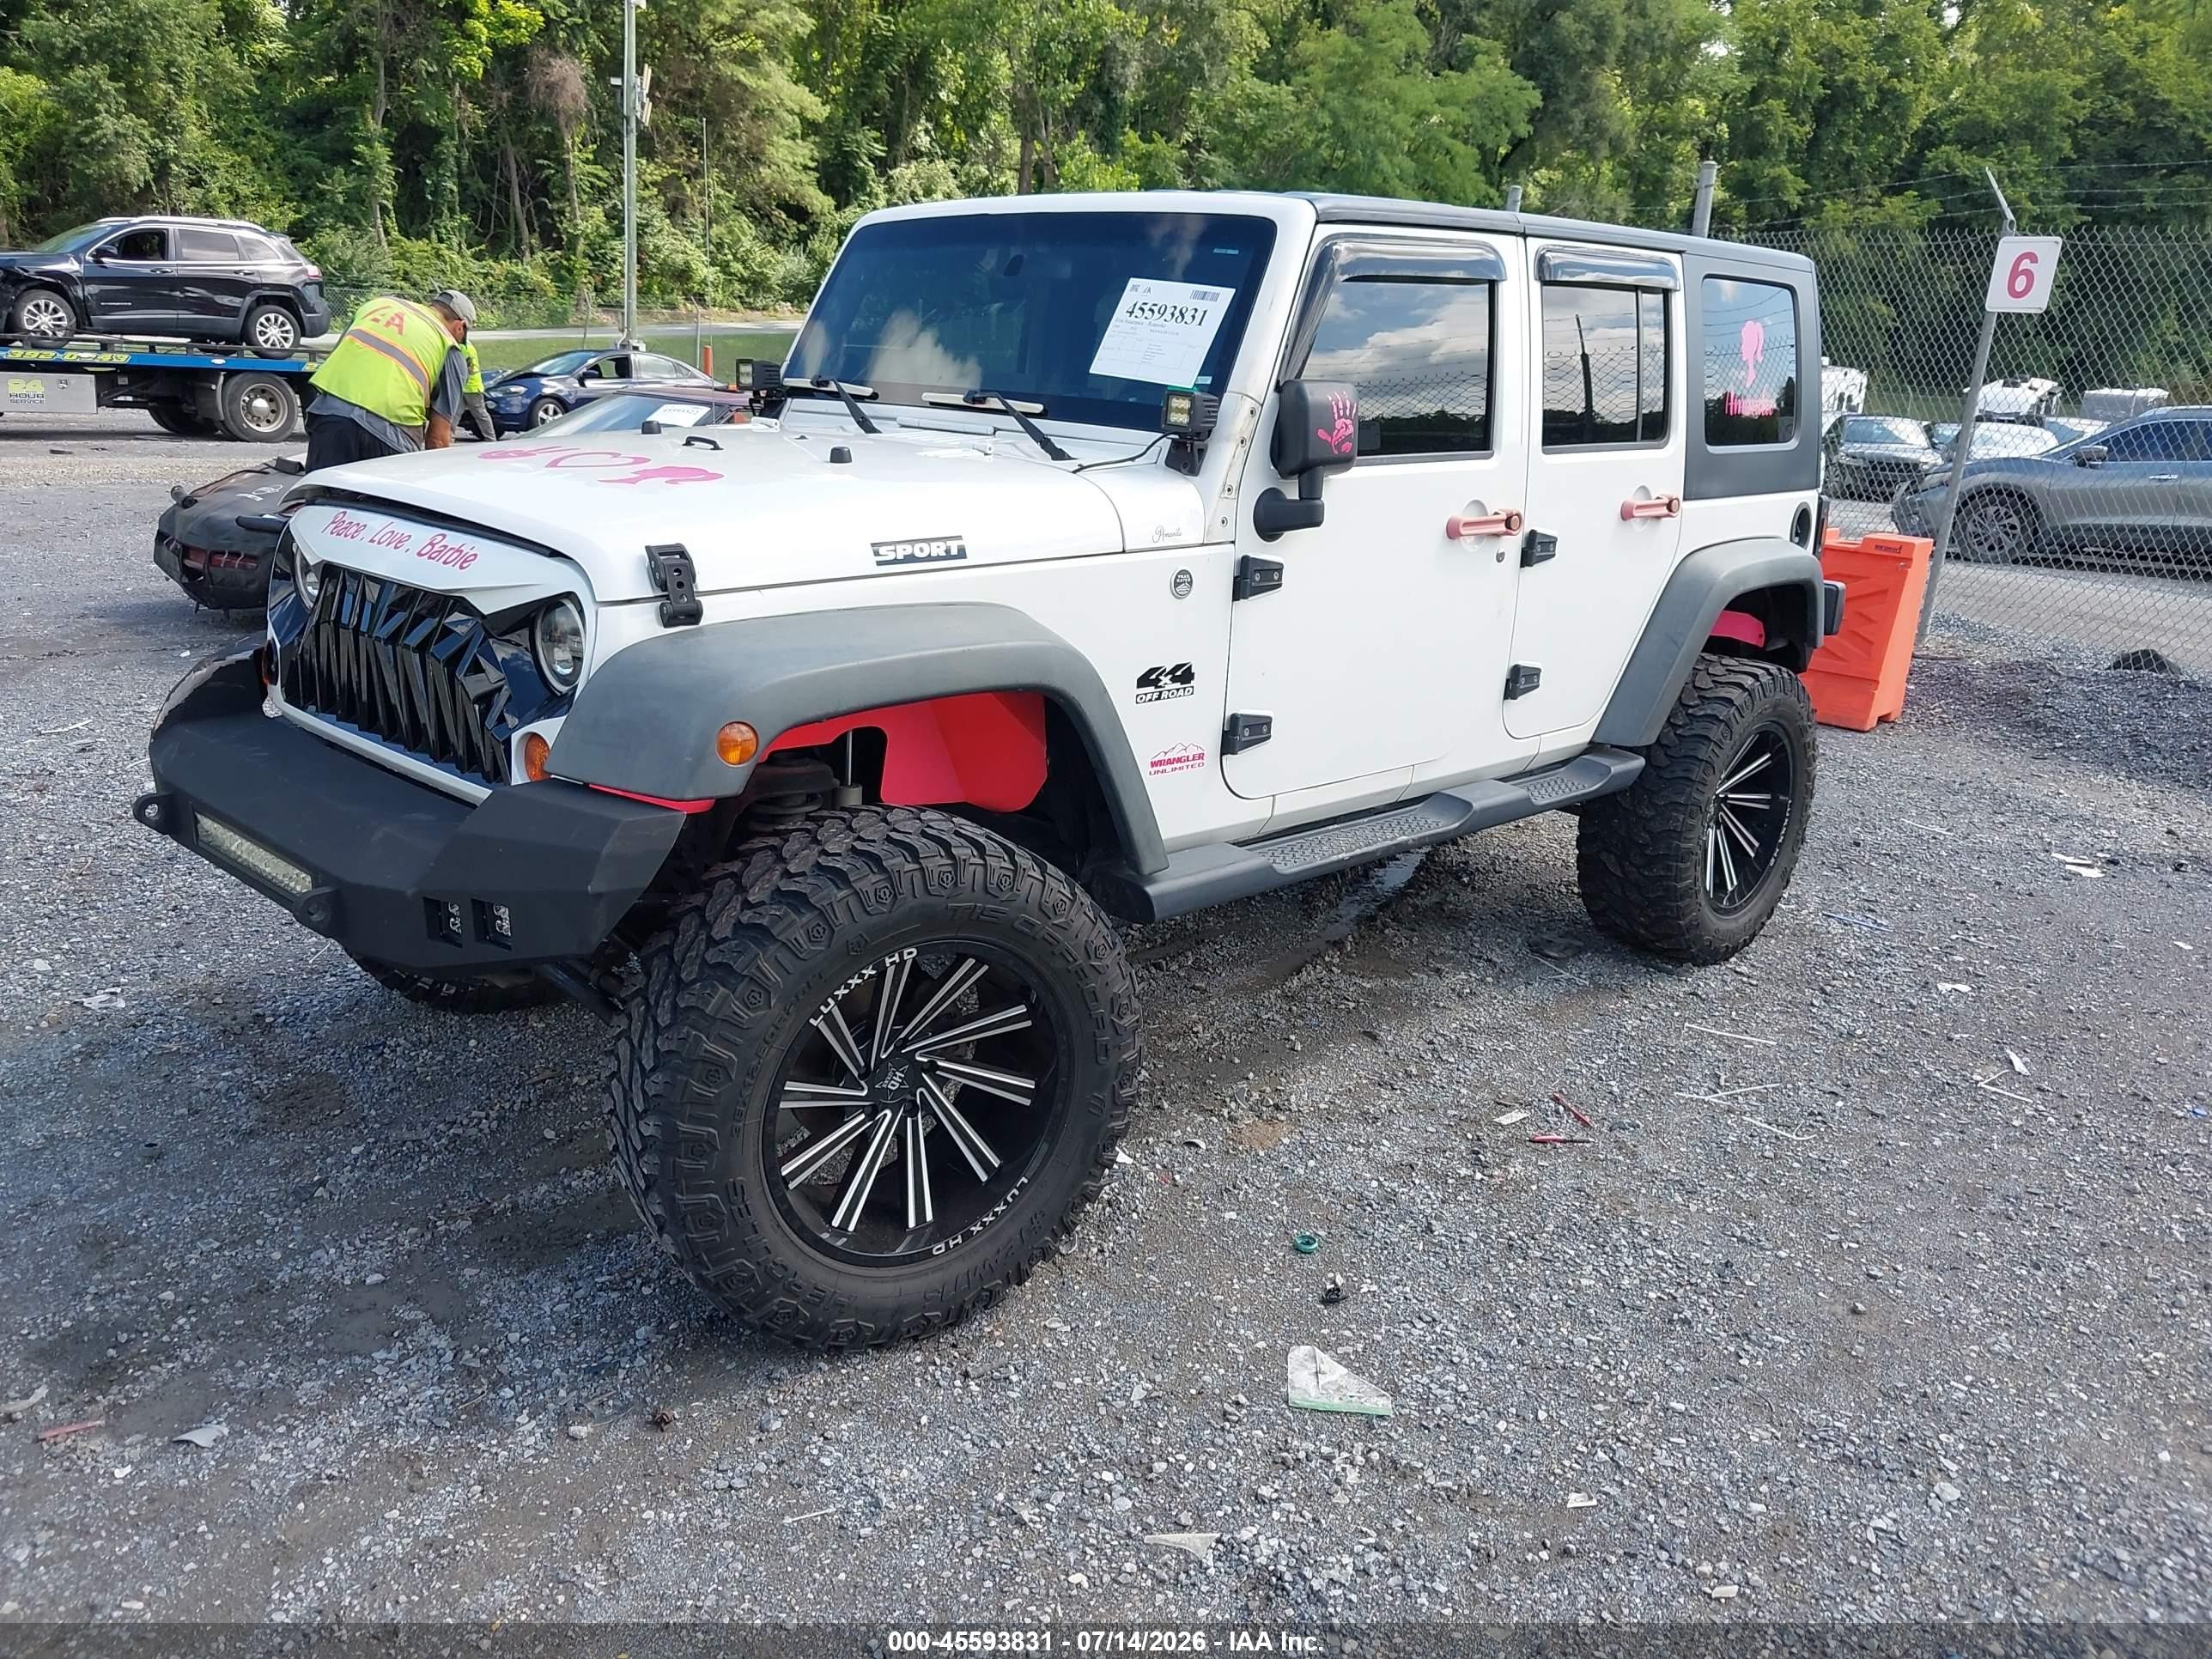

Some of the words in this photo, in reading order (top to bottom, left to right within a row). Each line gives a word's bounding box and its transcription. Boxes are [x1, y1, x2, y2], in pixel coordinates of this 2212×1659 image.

[2007, 251, 2039, 299] 6
[1125, 301, 1208, 326] 45593831
[8, 378, 45, 392] 24
[416, 532, 478, 570] Barbie
[874, 539, 963, 562] SPORT
[1136, 692, 1160, 703] OFF
[1160, 687, 1194, 700] ROAD
[1148, 762, 1205, 776] UNLIMITED
[1150, 752, 1205, 769] WRANGLER
[809, 963, 877, 1026] LUXXX
[884, 947, 918, 967] HD
[888, 1072, 905, 1091] HD
[969, 1176, 1029, 1237] LUXXX
[932, 1234, 963, 1255] HD
